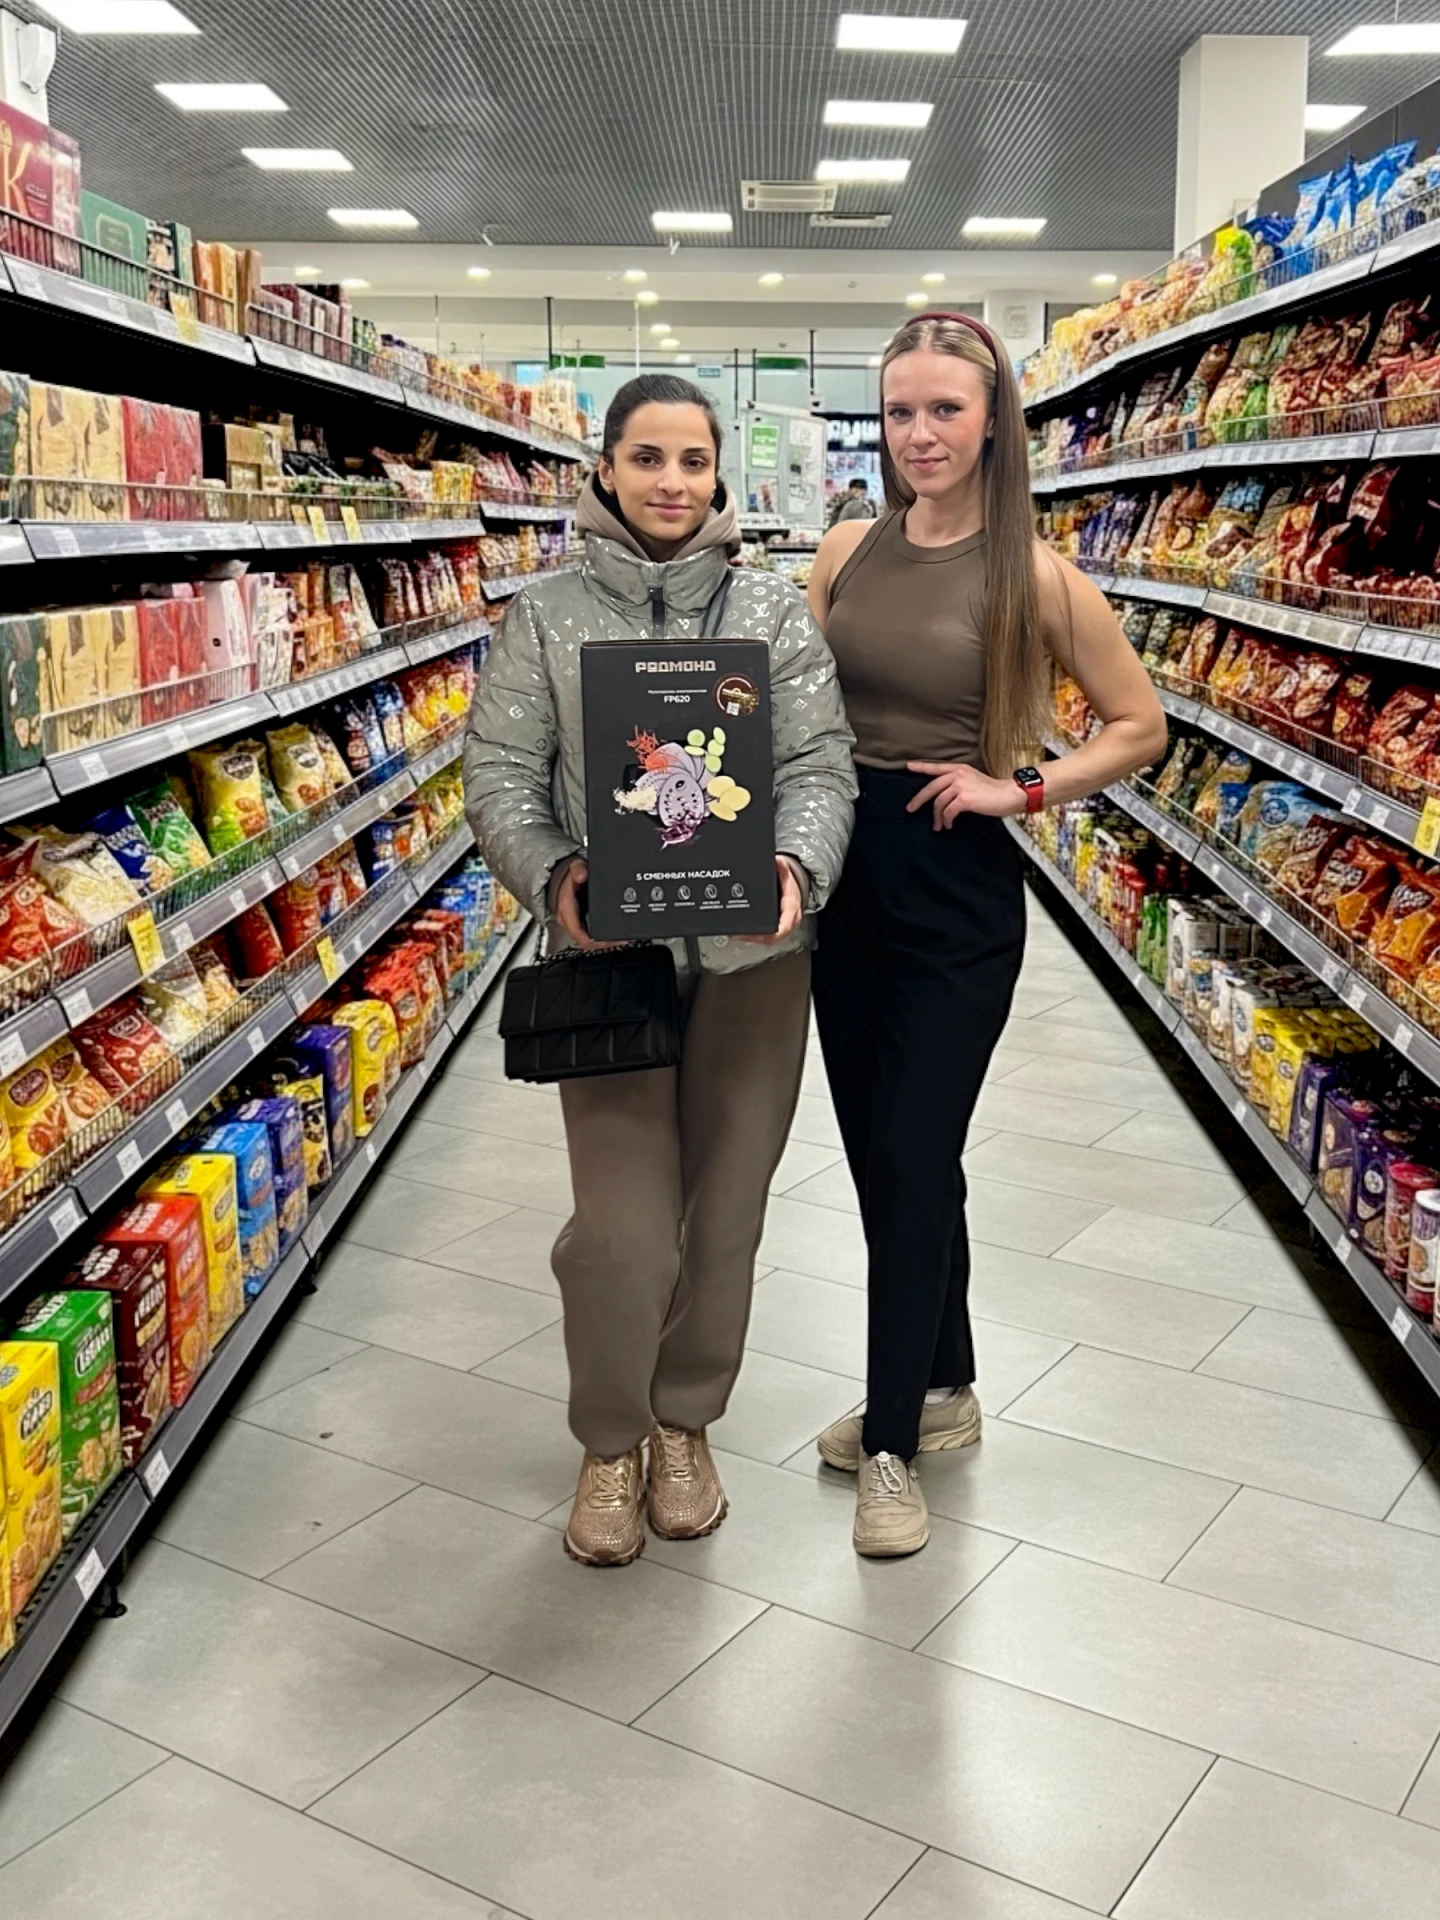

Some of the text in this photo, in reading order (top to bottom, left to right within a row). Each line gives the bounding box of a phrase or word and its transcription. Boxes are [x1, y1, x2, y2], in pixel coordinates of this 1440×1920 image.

[635, 660, 717, 673] РЕДМОНД
[663, 695, 691, 703] FP620
[636, 869, 731, 881] 5 СМЕННЫХ НАСАДОК
